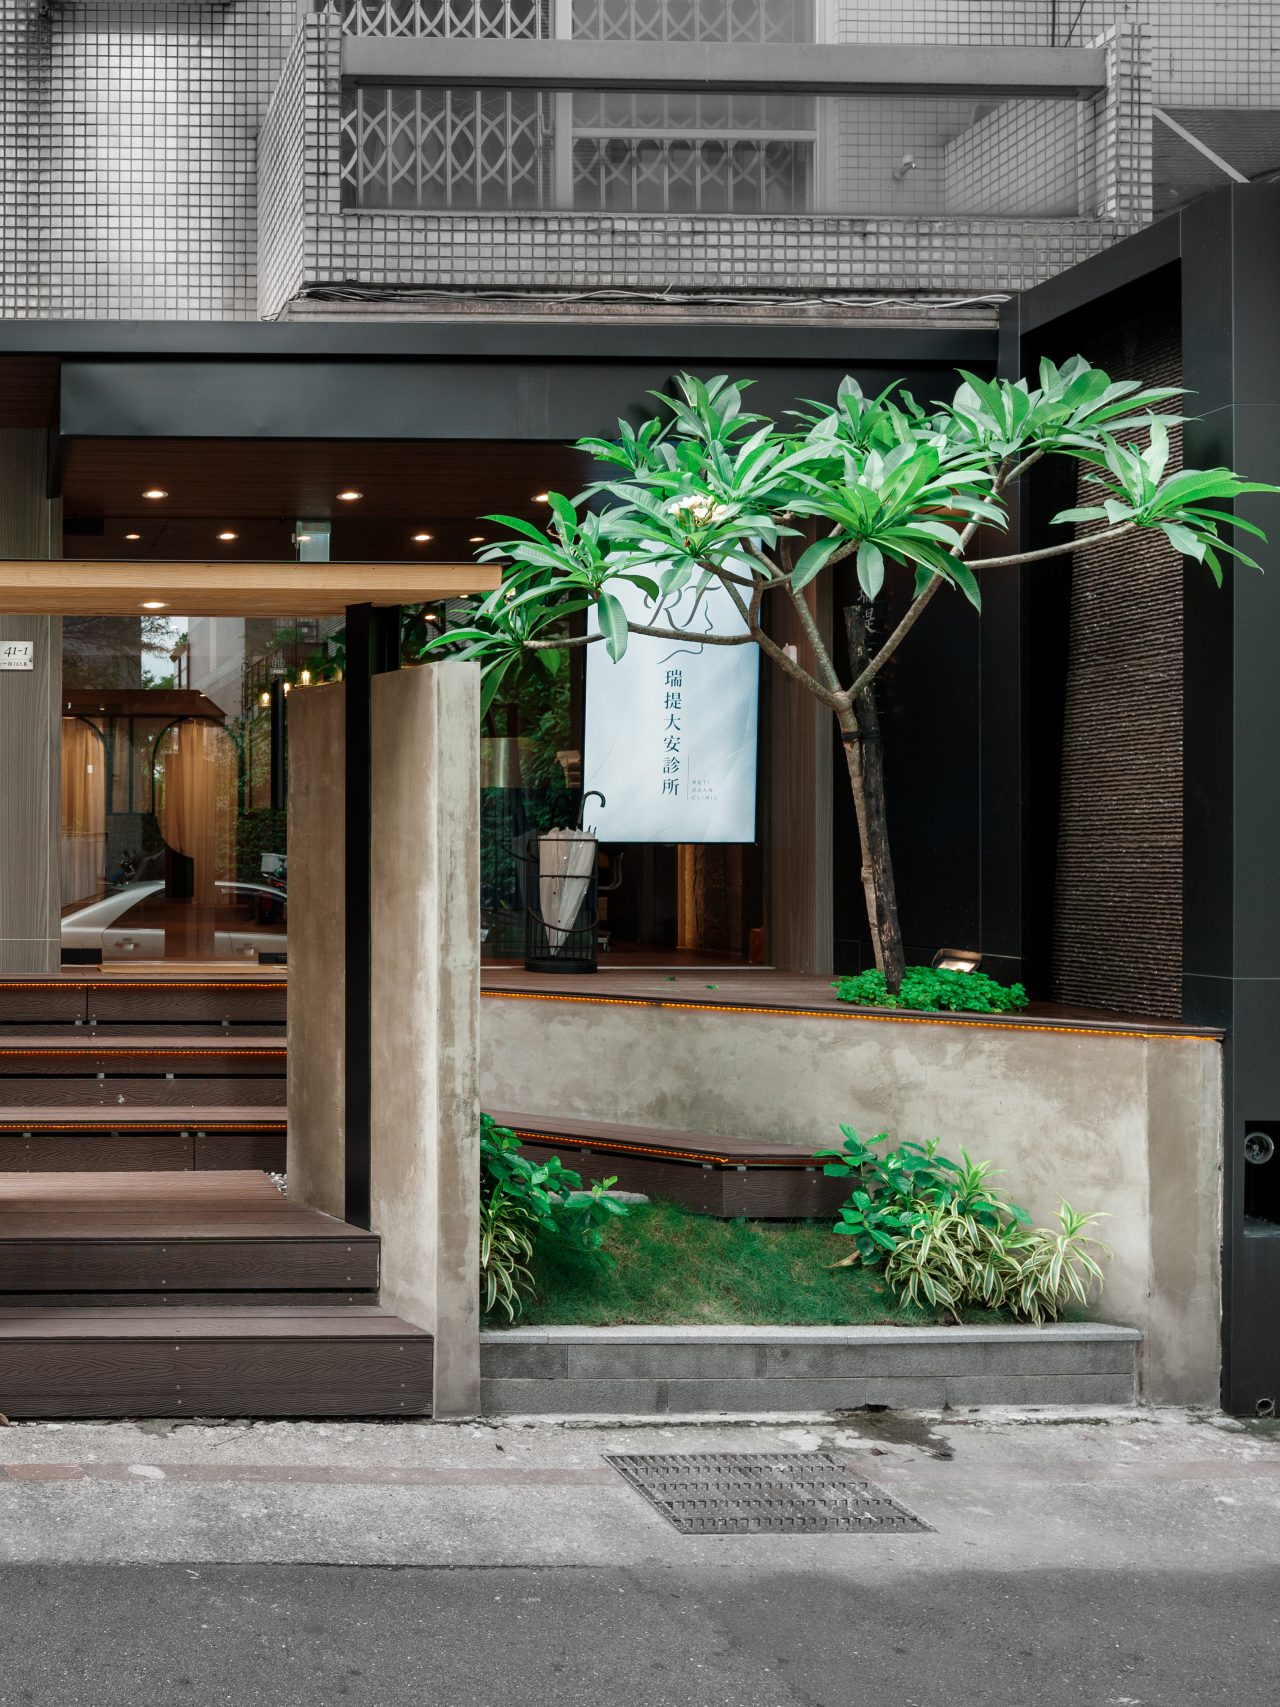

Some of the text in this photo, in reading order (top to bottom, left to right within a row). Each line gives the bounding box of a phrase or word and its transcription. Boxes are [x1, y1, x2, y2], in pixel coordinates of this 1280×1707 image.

[662, 669, 683, 797] 瑞提大安診所
